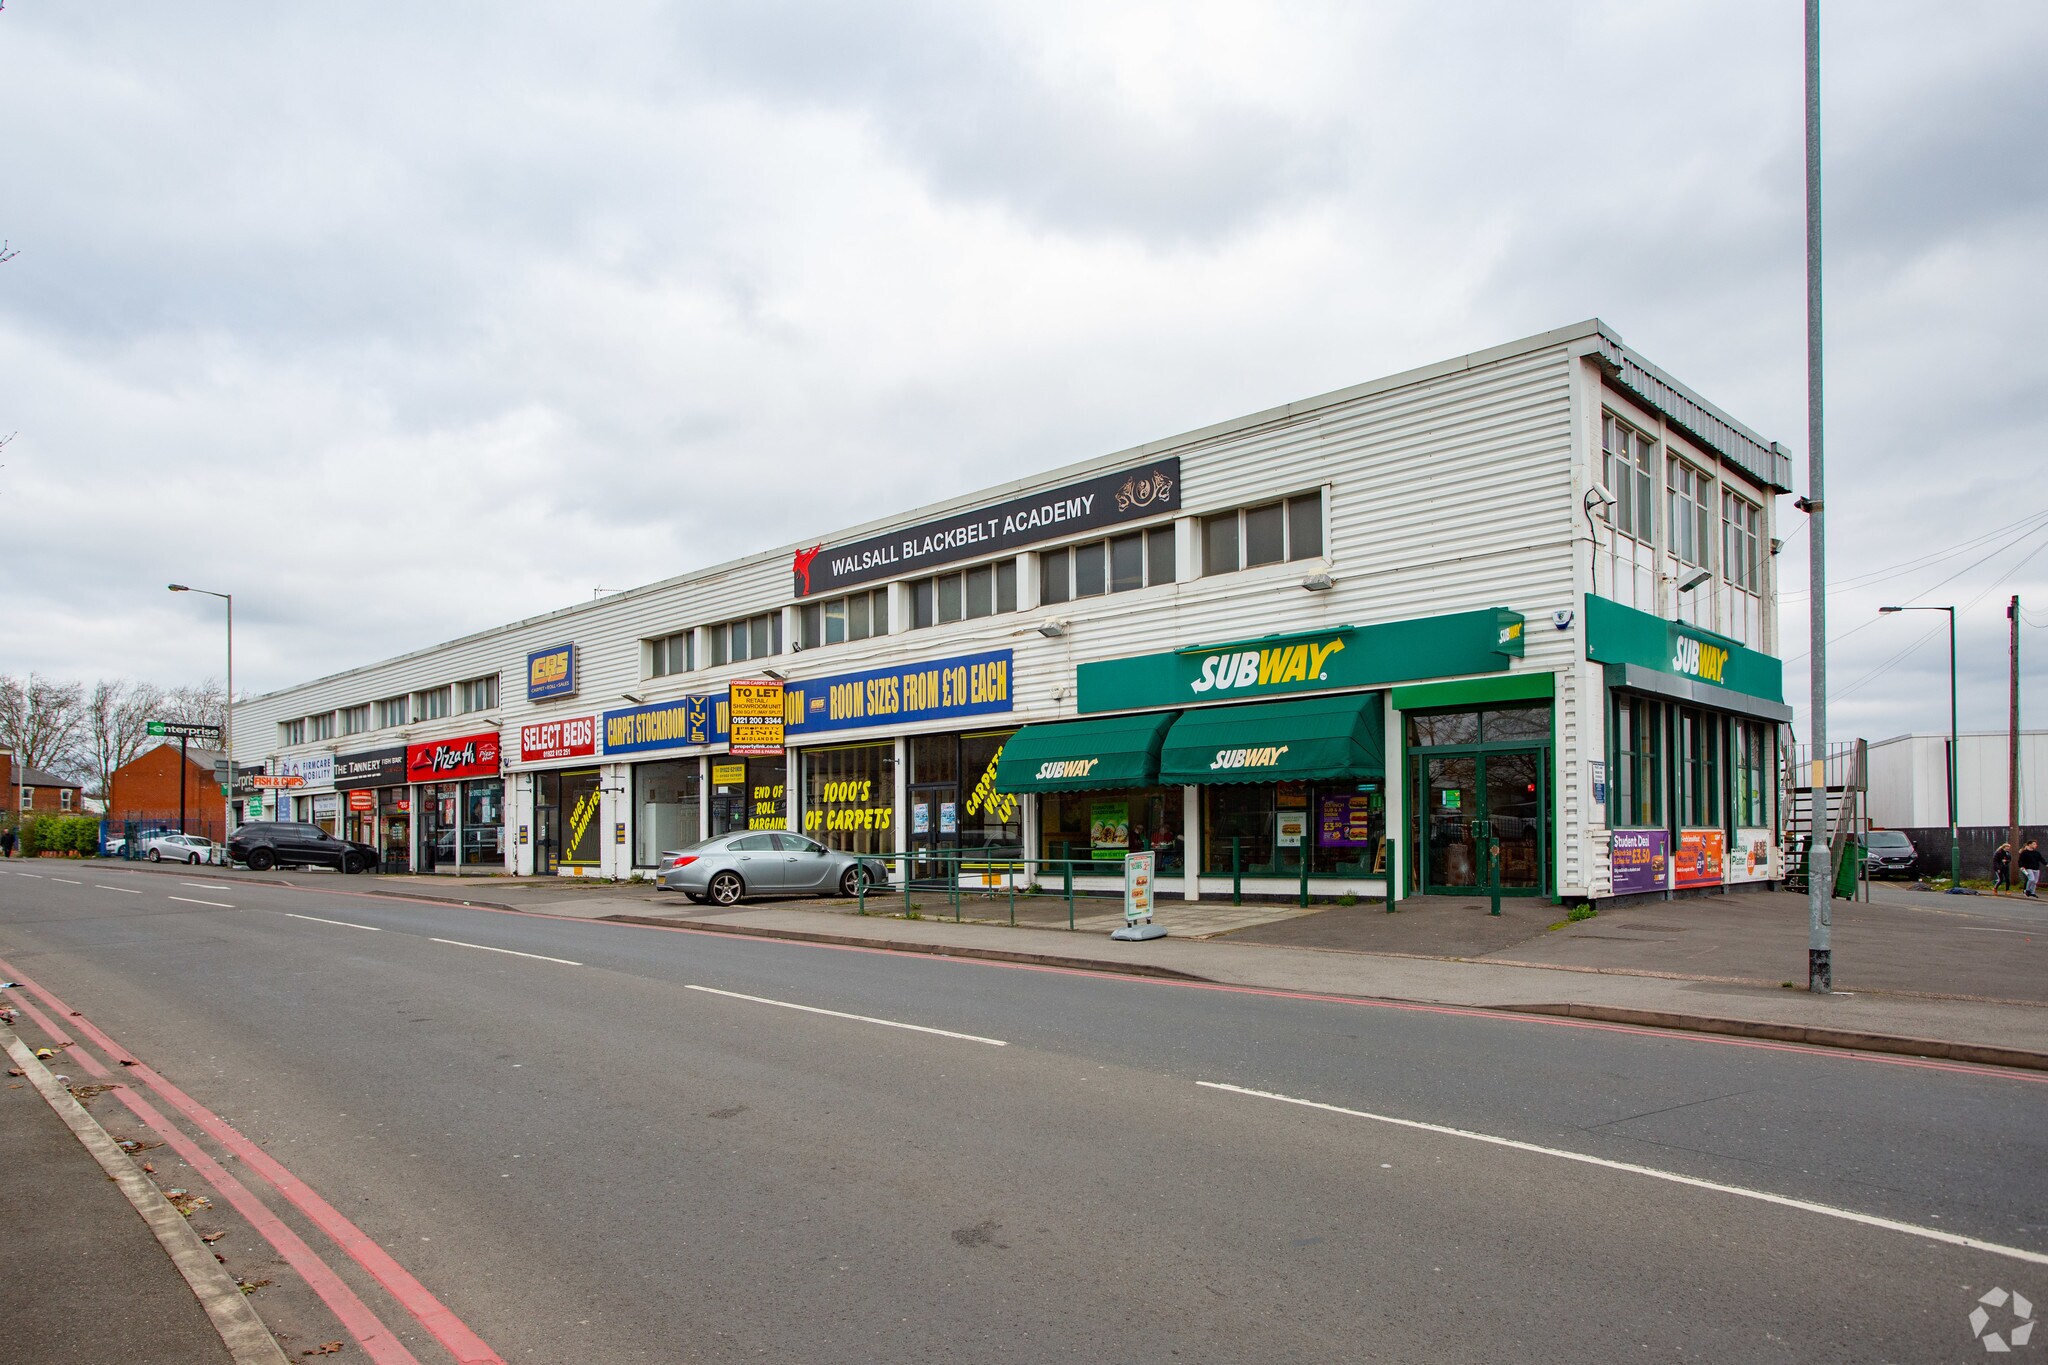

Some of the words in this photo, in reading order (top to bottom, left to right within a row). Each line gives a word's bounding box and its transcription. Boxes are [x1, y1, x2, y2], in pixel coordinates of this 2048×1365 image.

[831, 548, 899, 576] WALSALL
[902, 518, 998, 555] BLACKBELT
[1003, 494, 1095, 536] ACADEMY
[1499, 622, 1522, 645] SUBWAY
[532, 652, 569, 685] CRS
[1191, 637, 1345, 694] SUBWAY
[1672, 635, 1728, 682] SUBWAY
[736, 688, 752, 697] TO
[757, 688, 778, 697] LET
[830, 681, 864, 720] ROOM
[866, 676, 899, 716] SIZES
[903, 670, 939, 712] FROM
[942, 665, 967, 707] £10
[971, 660, 1007, 704] EACH
[151, 725, 219, 736] enterprise
[523, 724, 561, 752] SELECT
[563, 719, 592, 747] BEDS
[608, 714, 635, 747] CARPET
[636, 707, 686, 744] STOCKROOM
[303, 759, 330, 770] FIRMCARE
[433, 746, 461, 772] Pizza
[479, 750, 495, 758] Pizza
[1210, 745, 1288, 770] SUBWAY
[335, 764, 347, 775] THE
[349, 760, 381, 773] TANNERY
[1035, 758, 1098, 781] SUBWAY
[254, 777, 271, 785] FISH
[274, 777, 278, 785] &
[754, 786, 771, 799] END
[773, 785, 784, 798] OF
[823, 780, 871, 803] 1000'S
[570, 795, 586, 829] RUGS
[756, 802, 776, 815] ROLL
[805, 810, 823, 831] OF
[827, 808, 892, 831] CARPETS
[749, 817, 787, 830] BARGAINS
[1614, 835, 1637, 847] Student
[1638, 835, 1650, 847] Deal
